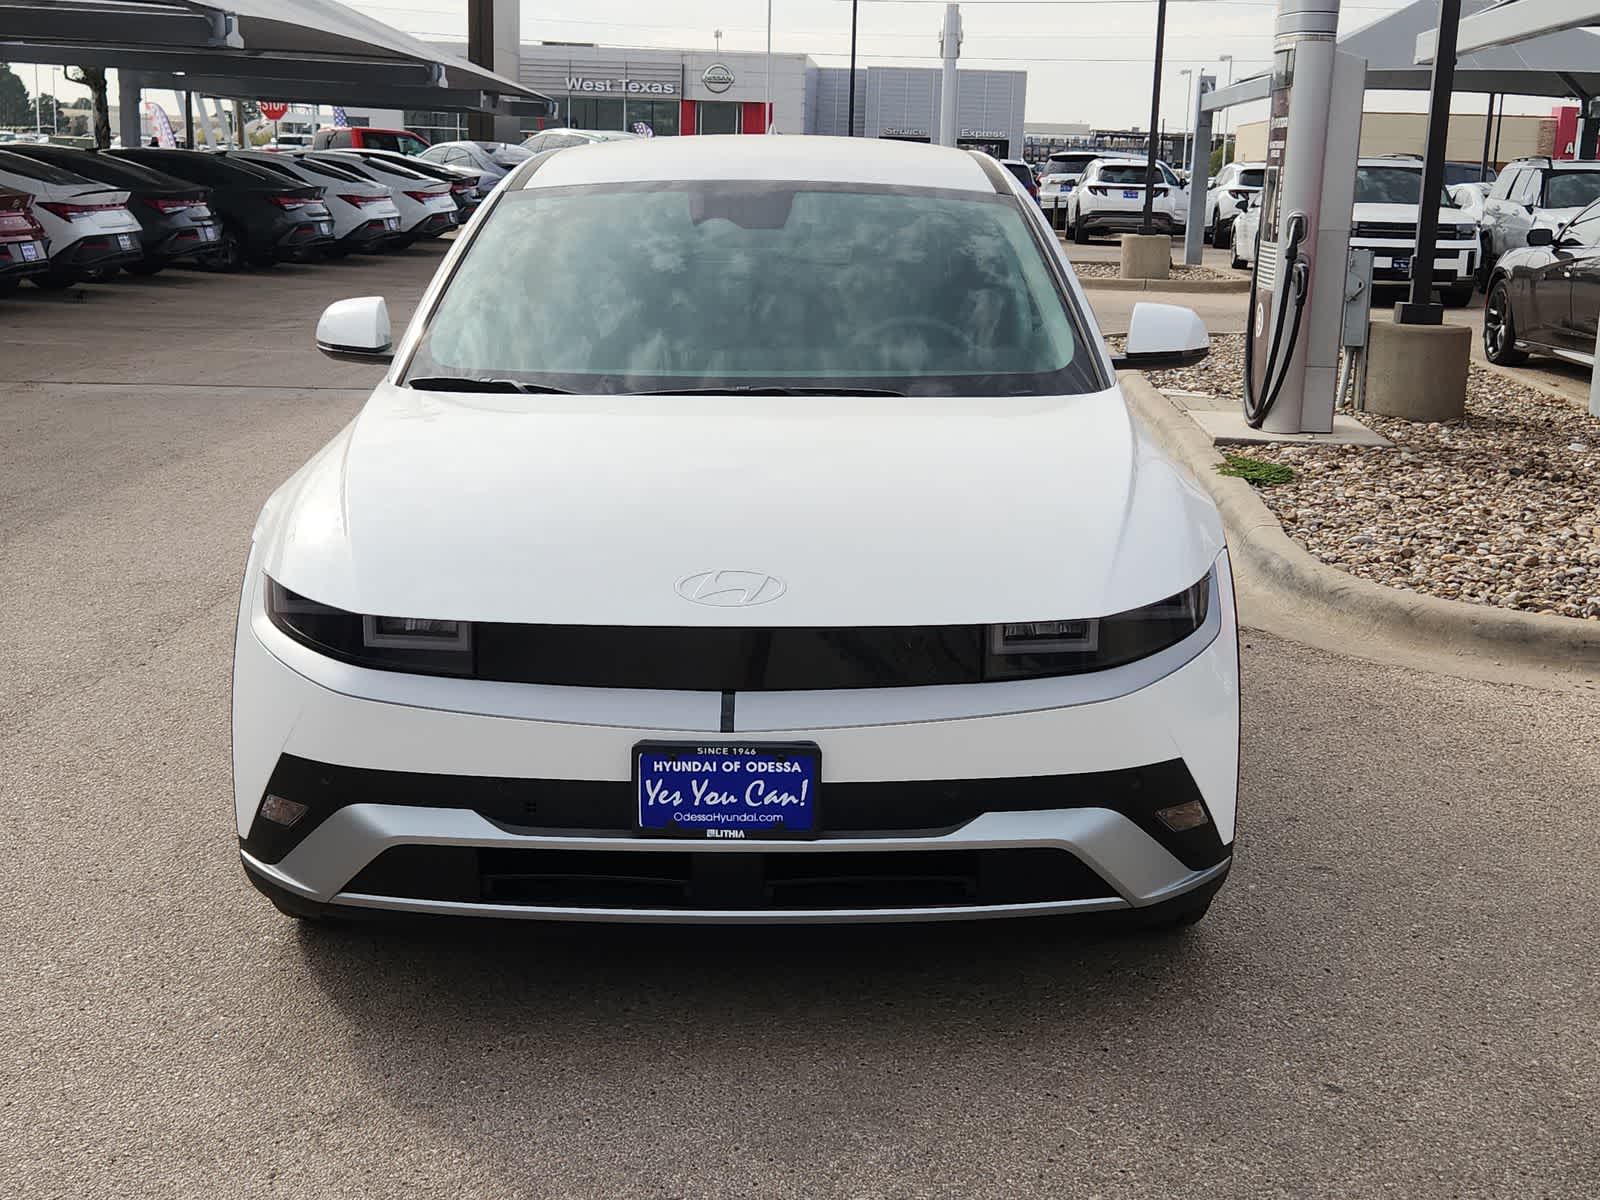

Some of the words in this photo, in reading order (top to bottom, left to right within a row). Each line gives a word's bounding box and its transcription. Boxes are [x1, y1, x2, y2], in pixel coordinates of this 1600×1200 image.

[565, 77, 612, 92] West
[618, 79, 674, 94] Texas
[961, 128, 1006, 138] Express
[697, 747, 729, 755] SINCE
[732, 747, 757, 755] 1946
[653, 761, 717, 773] HYUNDAI
[721, 761, 741, 773] OF
[746, 761, 801, 773] ODESSA
[645, 779, 683, 807] Yes
[691, 779, 738, 806] You
[745, 779, 808, 807] Can!
[673, 812, 784, 824] OdessaHyundai.com
[715, 829, 745, 839] LITHIA
